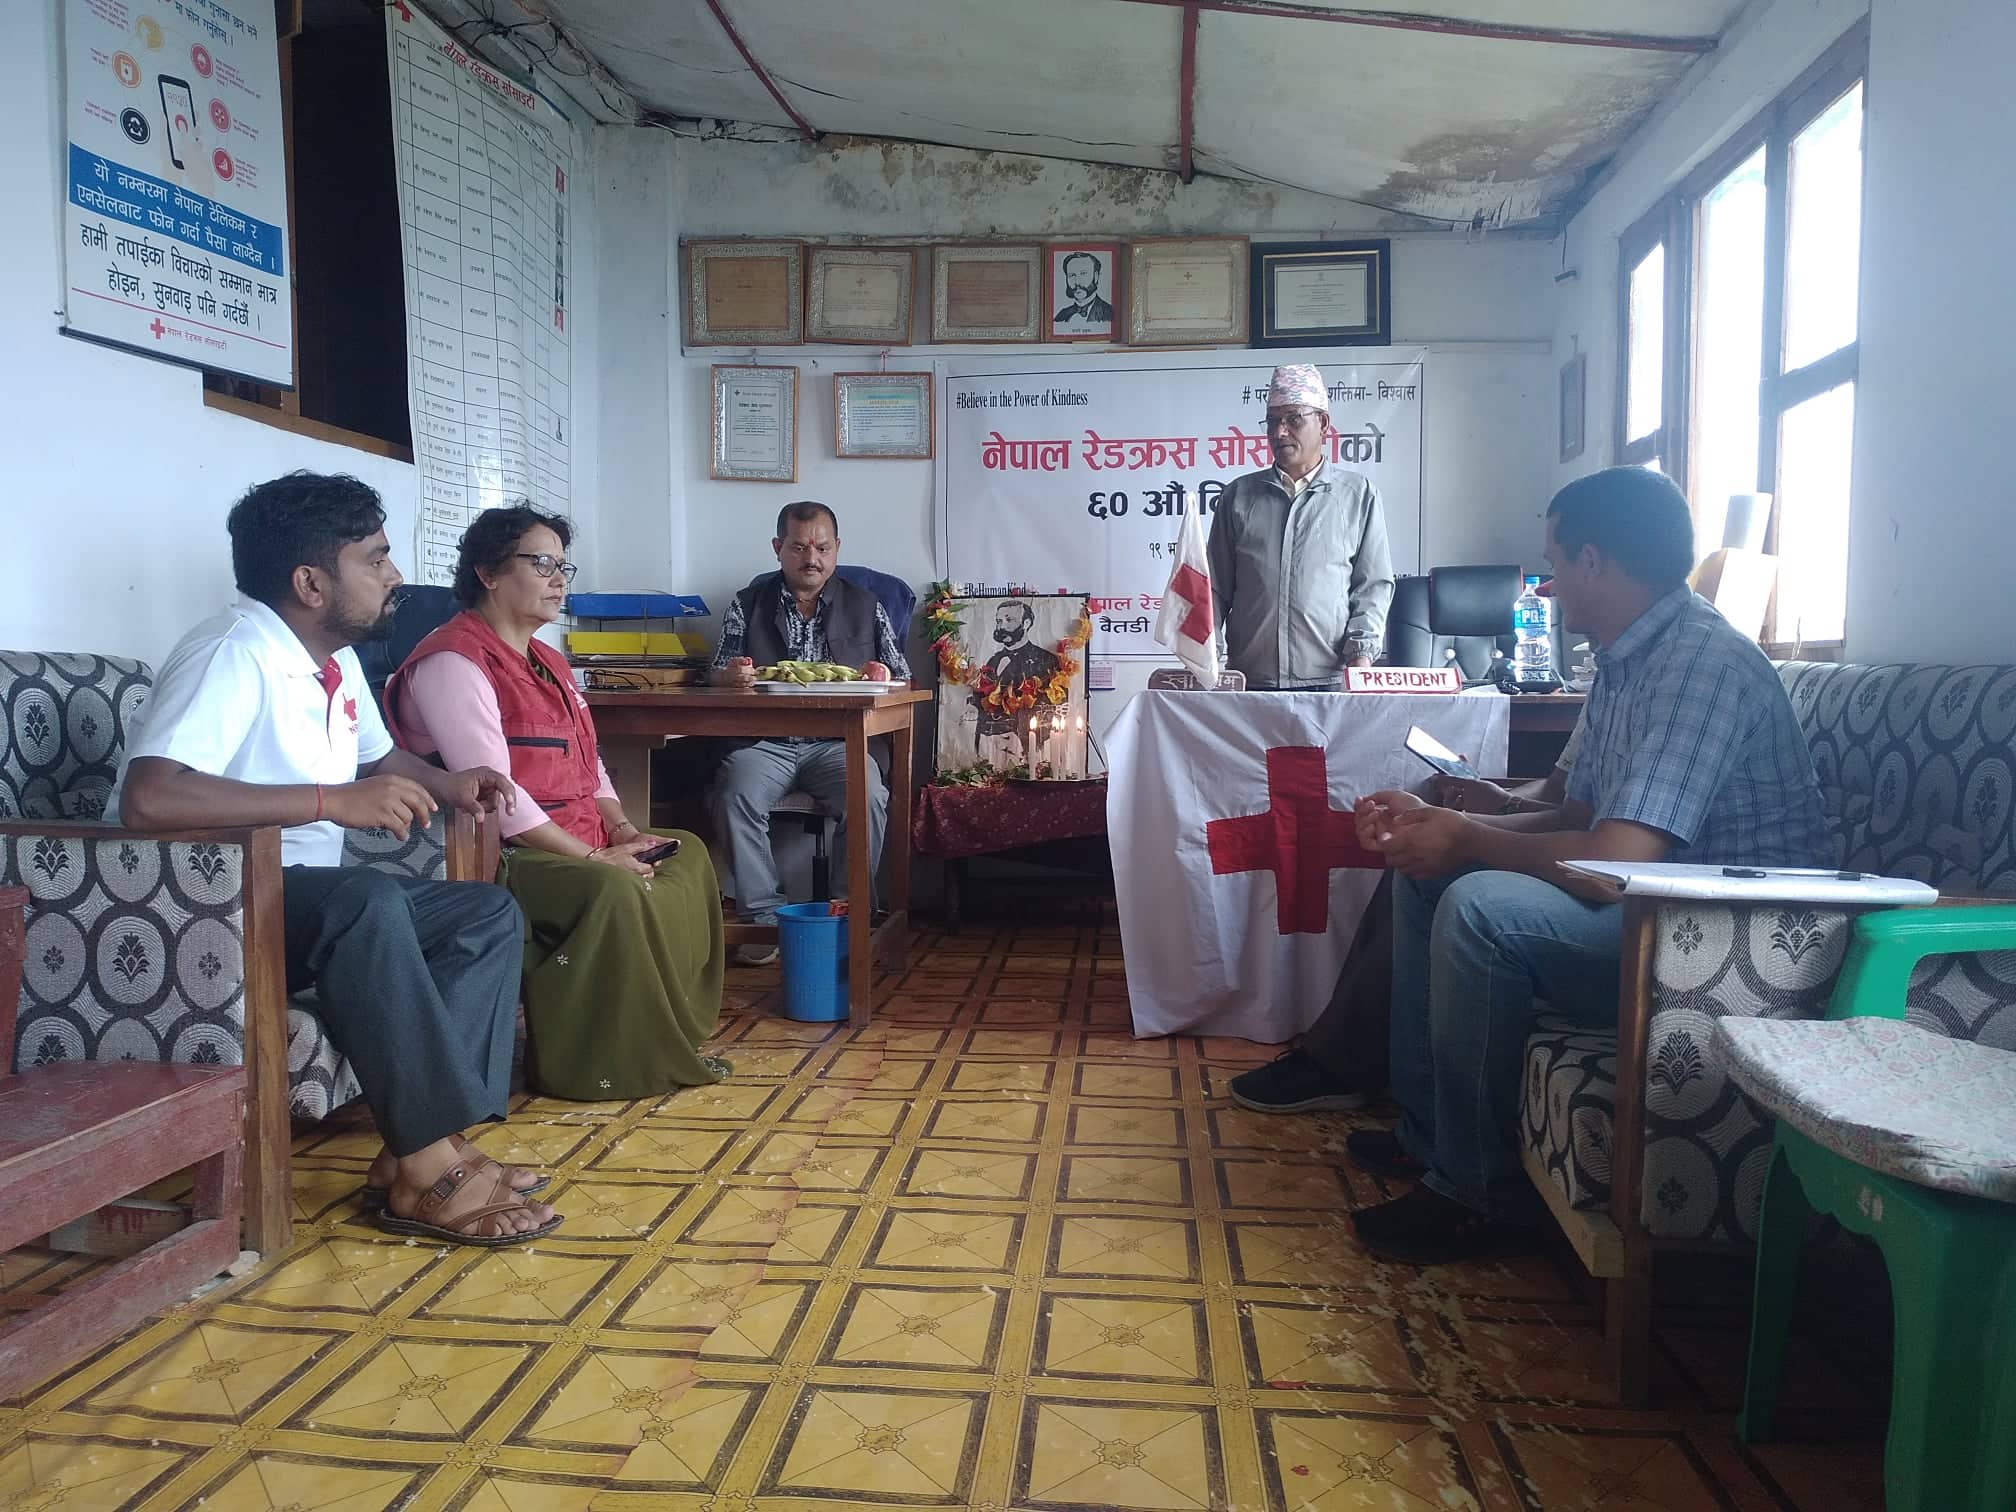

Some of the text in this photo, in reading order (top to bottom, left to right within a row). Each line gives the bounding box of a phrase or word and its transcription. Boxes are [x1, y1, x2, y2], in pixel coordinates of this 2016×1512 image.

[93, 159, 110, 182] यो
[116, 171, 168, 203] नम्बरमा
[173, 186, 204, 217] नेपाल
[250, 223, 258, 240] र
[76, 183, 143, 221] एनसेलबाट
[147, 206, 174, 232] फोन
[179, 221, 201, 242] गर्दा
[204, 226, 227, 252] पैसा
[80, 222, 109, 252] हामी
[170, 245, 213, 285] विचारको
[218, 269, 253, 297] सम्मान
[257, 283, 278, 305] मात्र
[152, 281, 192, 315] सुनवाइ
[196, 290, 217, 318] पनि
[956, 388, 1089, 409] #Believe in the Power of Kindness
[1377, 380, 1417, 401] विश्वास
[981, 431, 1073, 472] नेपाल
[1082, 429, 1198, 471] रेडक्रस
[1087, 491, 1129, 521] ६०
[1149, 542, 1163, 560] १९
[1099, 615, 1151, 634] बैतडी
[1359, 671, 1448, 688] PRESIDENT
